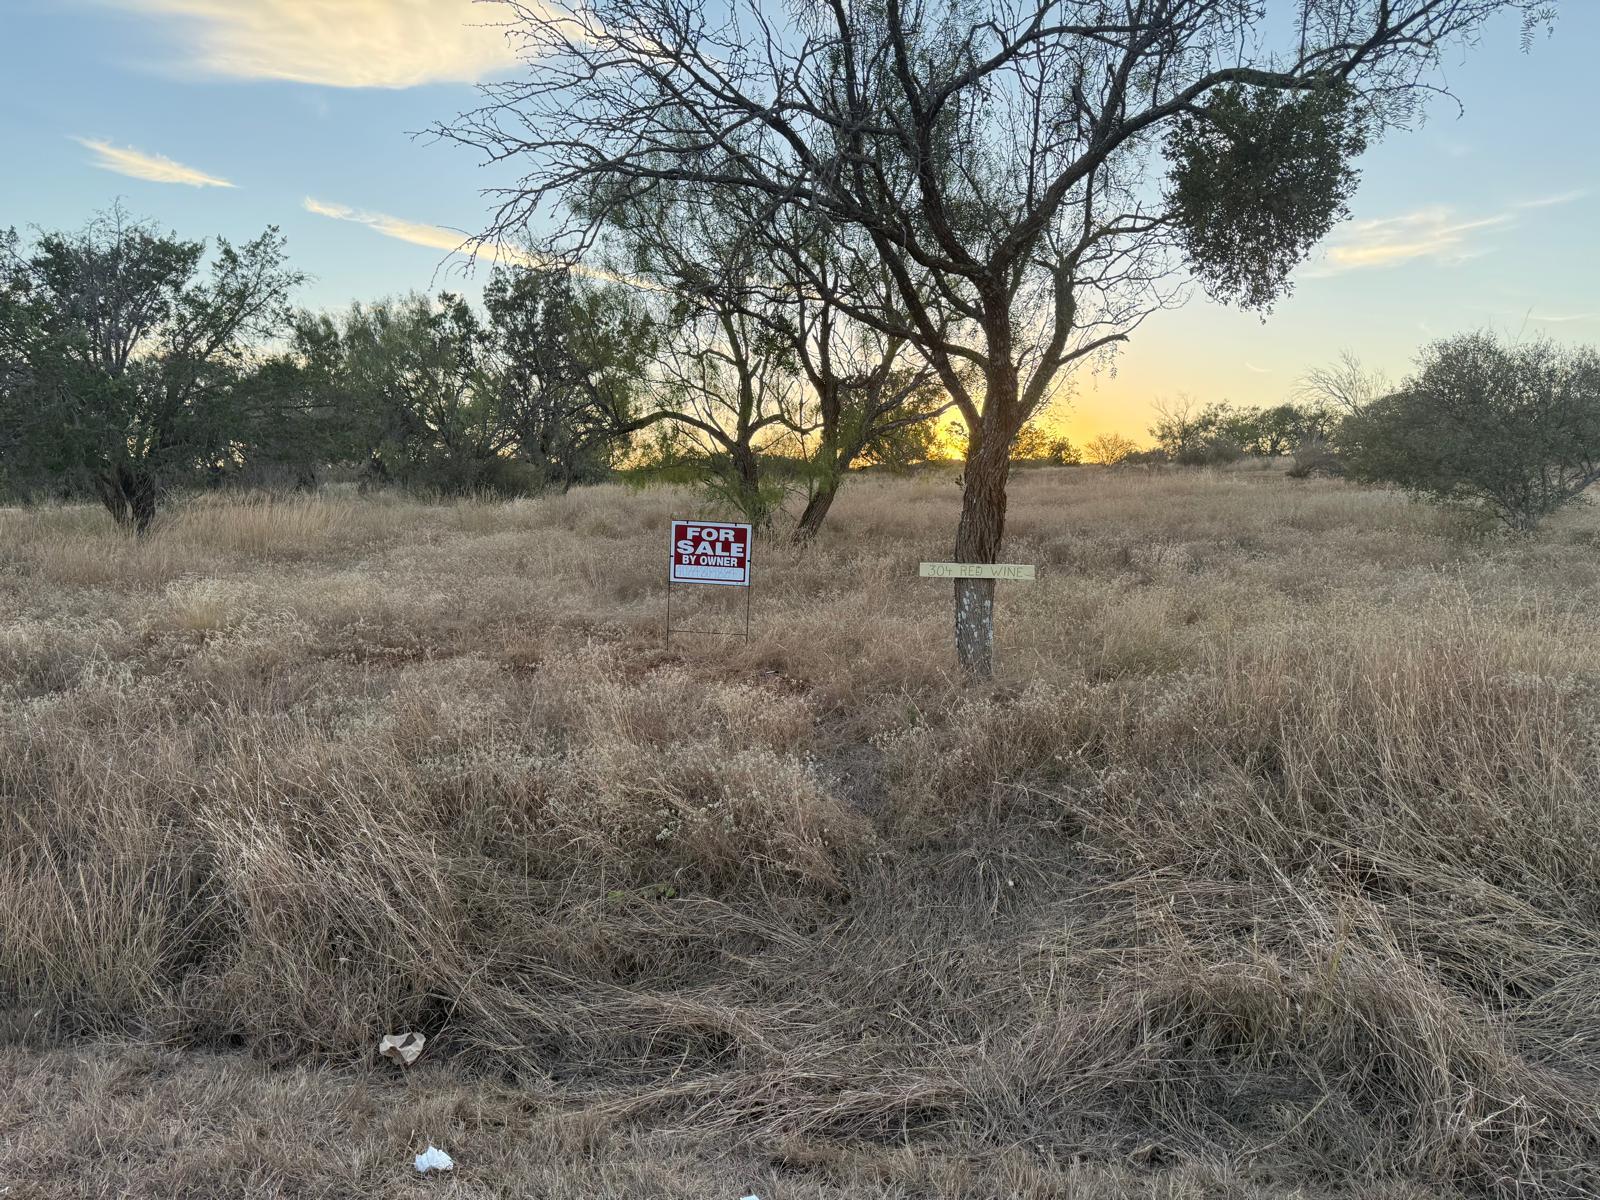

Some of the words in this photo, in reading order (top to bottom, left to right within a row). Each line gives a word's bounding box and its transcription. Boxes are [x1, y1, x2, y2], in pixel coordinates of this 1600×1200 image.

[687, 527, 735, 541] FOR
[677, 539, 744, 557] SALE
[682, 555, 696, 565] BY
[700, 556, 738, 567] OWNER
[928, 565, 952, 576] 304
[960, 565, 983, 576] RED
[990, 565, 1024, 577] WINE
